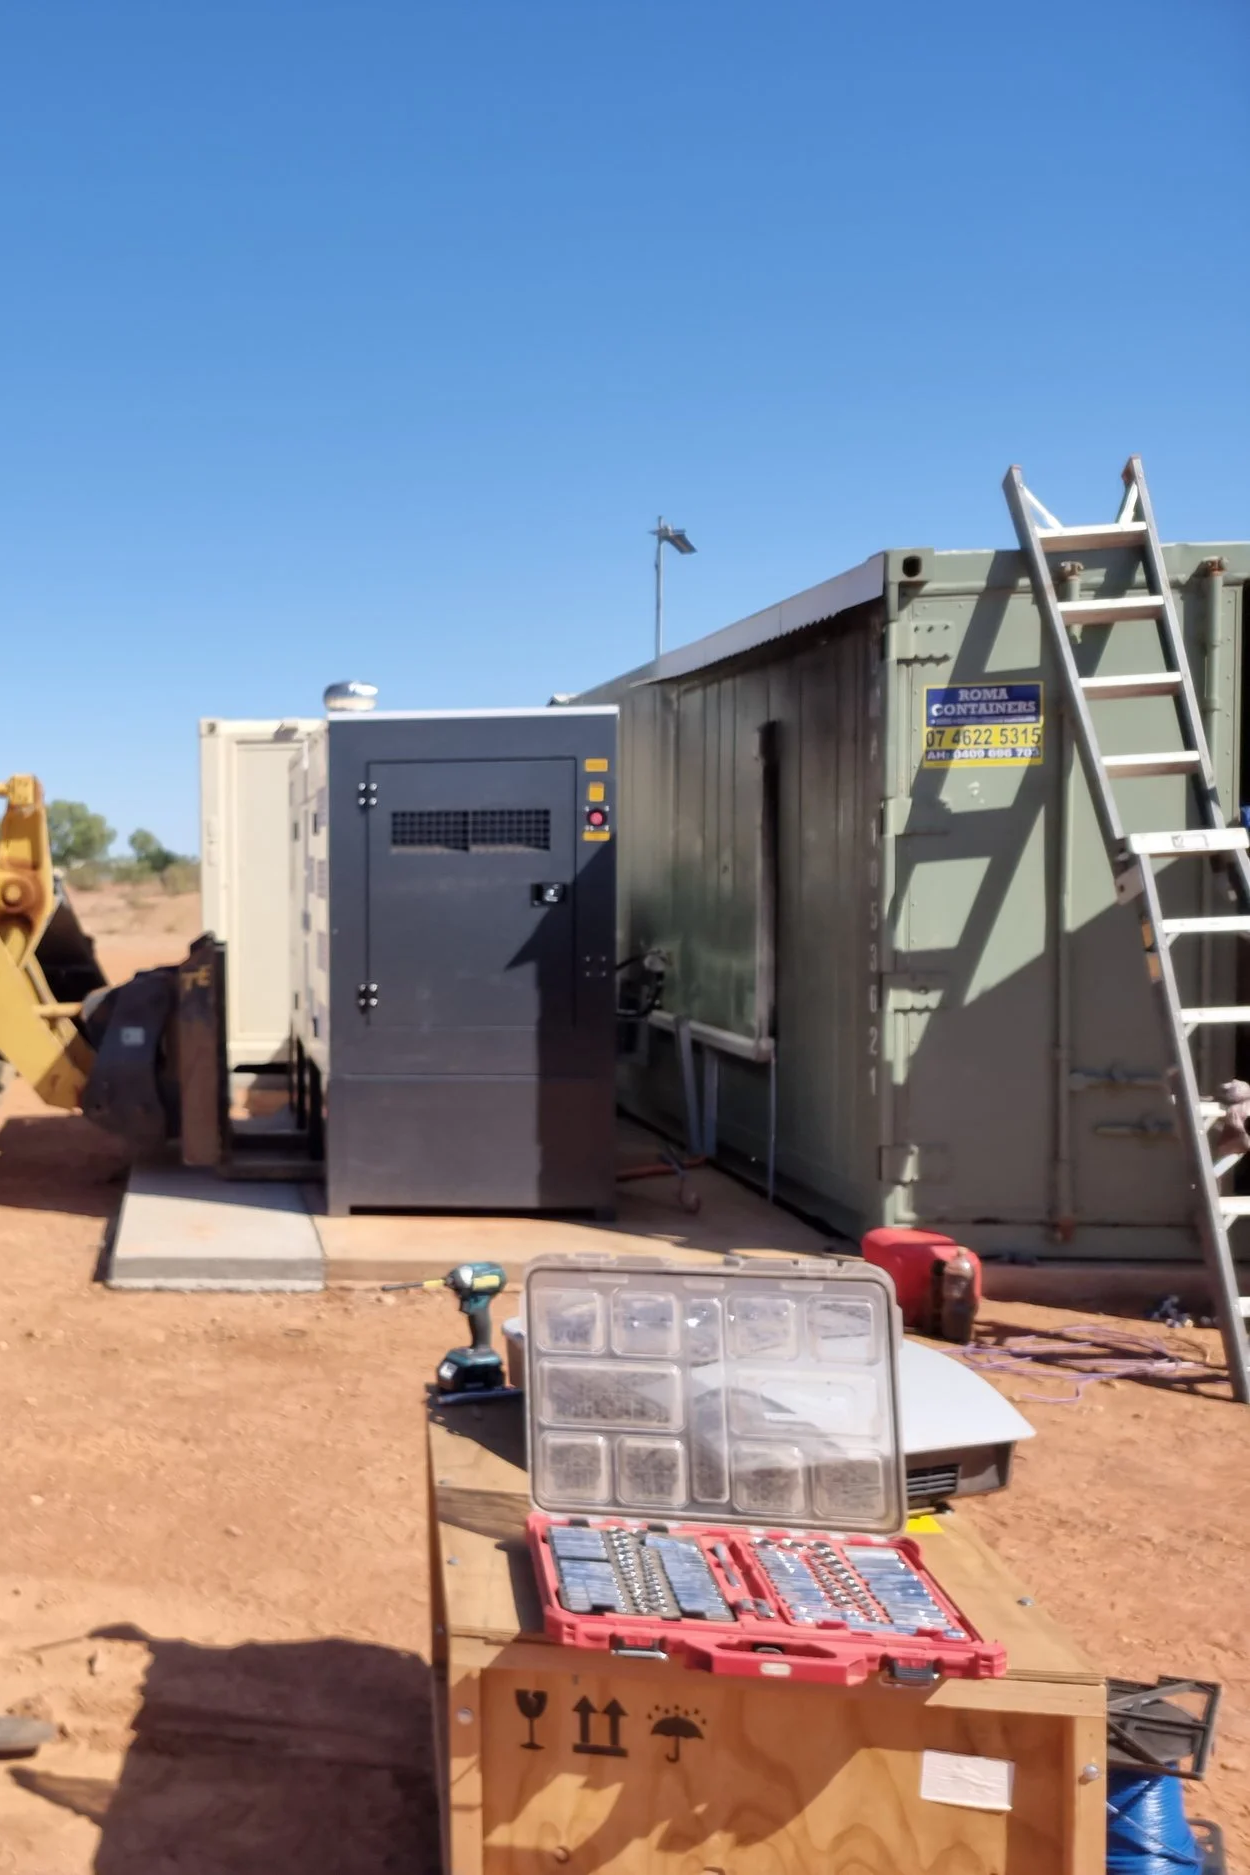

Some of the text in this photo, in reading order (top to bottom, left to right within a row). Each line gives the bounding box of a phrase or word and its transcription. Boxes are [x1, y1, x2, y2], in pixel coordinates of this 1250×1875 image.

[958, 687, 1009, 702] ROMA
[931, 700, 1036, 717] CONTAINERS
[926, 727, 1042, 748] 07 4622 5315
